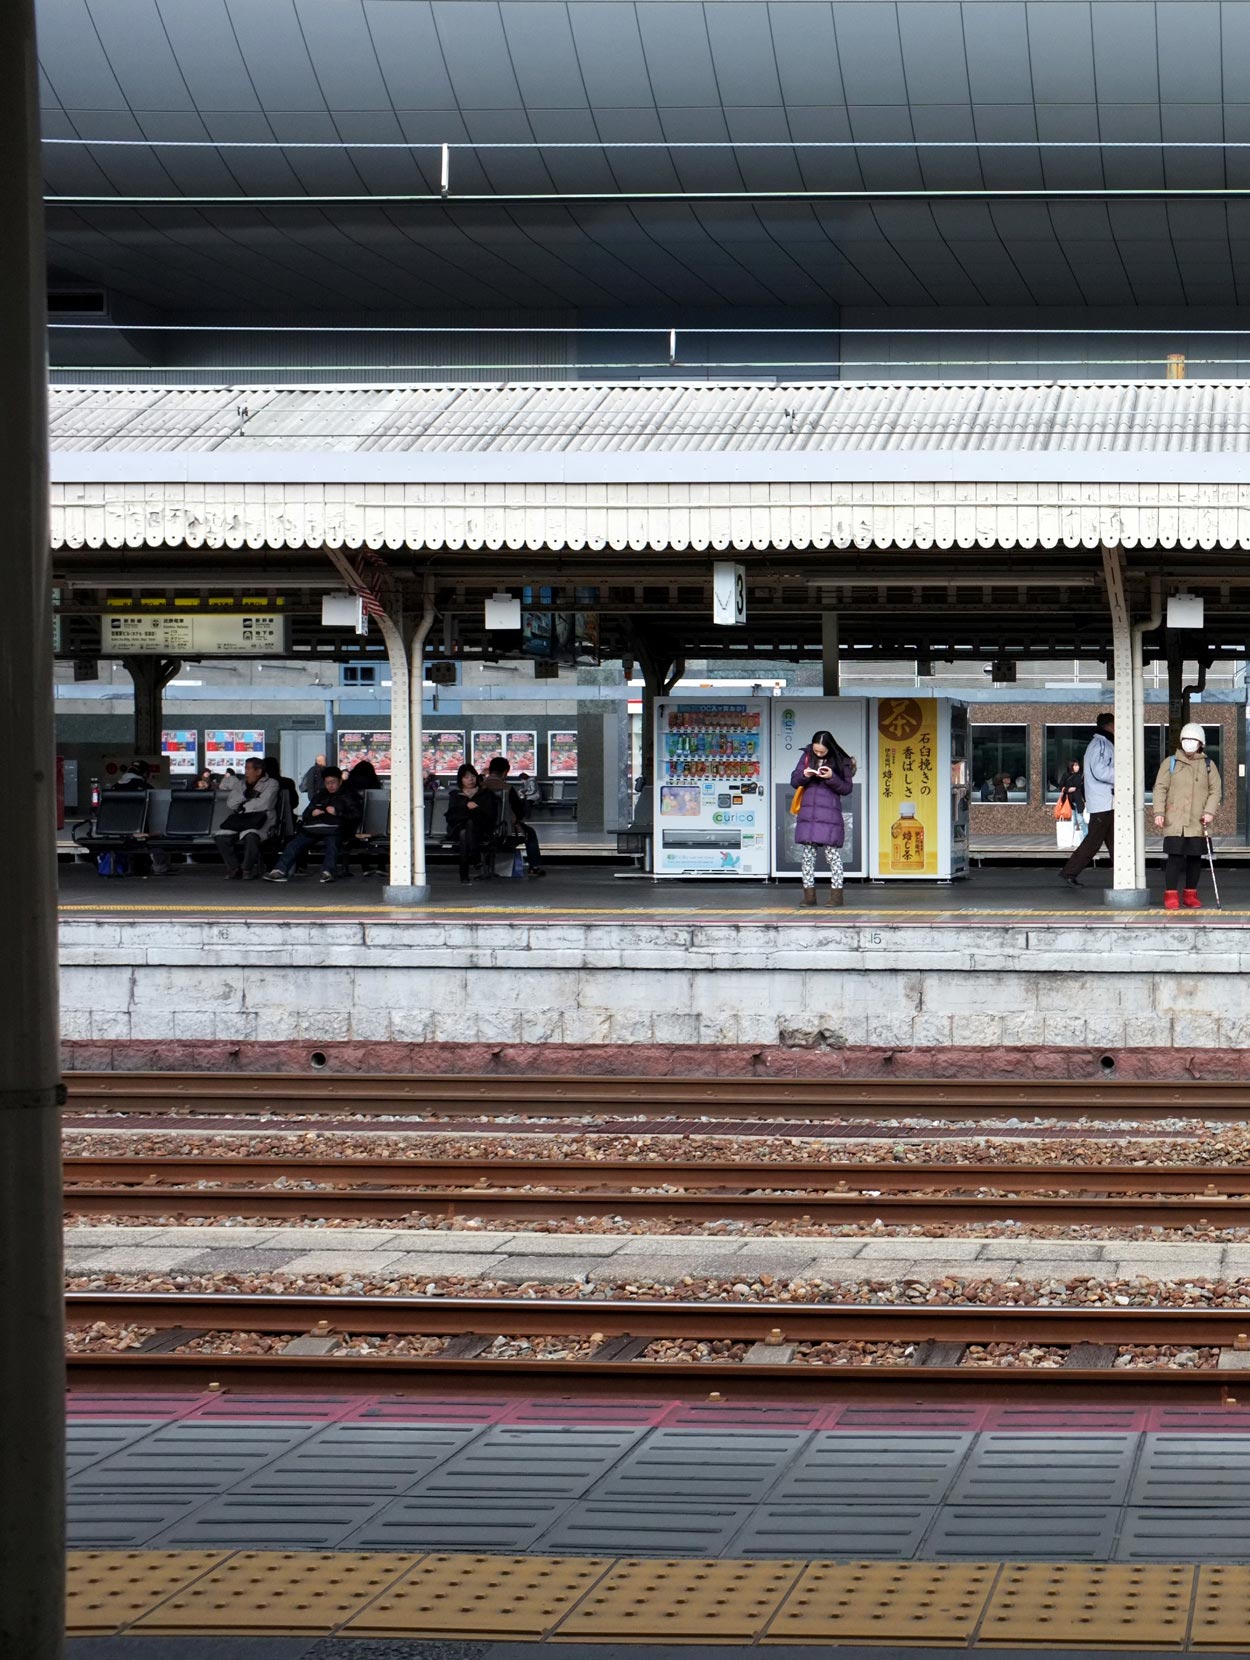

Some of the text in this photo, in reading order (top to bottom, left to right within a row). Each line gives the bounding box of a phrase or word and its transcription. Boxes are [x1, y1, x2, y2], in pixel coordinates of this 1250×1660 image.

[736, 573, 744, 615] 3
[784, 711, 794, 751] curico
[881, 700, 917, 737] 茶
[902, 746, 916, 798] 香ばしさ
[918, 733, 933, 796] 石臼挽きの
[715, 812, 754, 822] curico
[870, 932, 882, 944] 15
